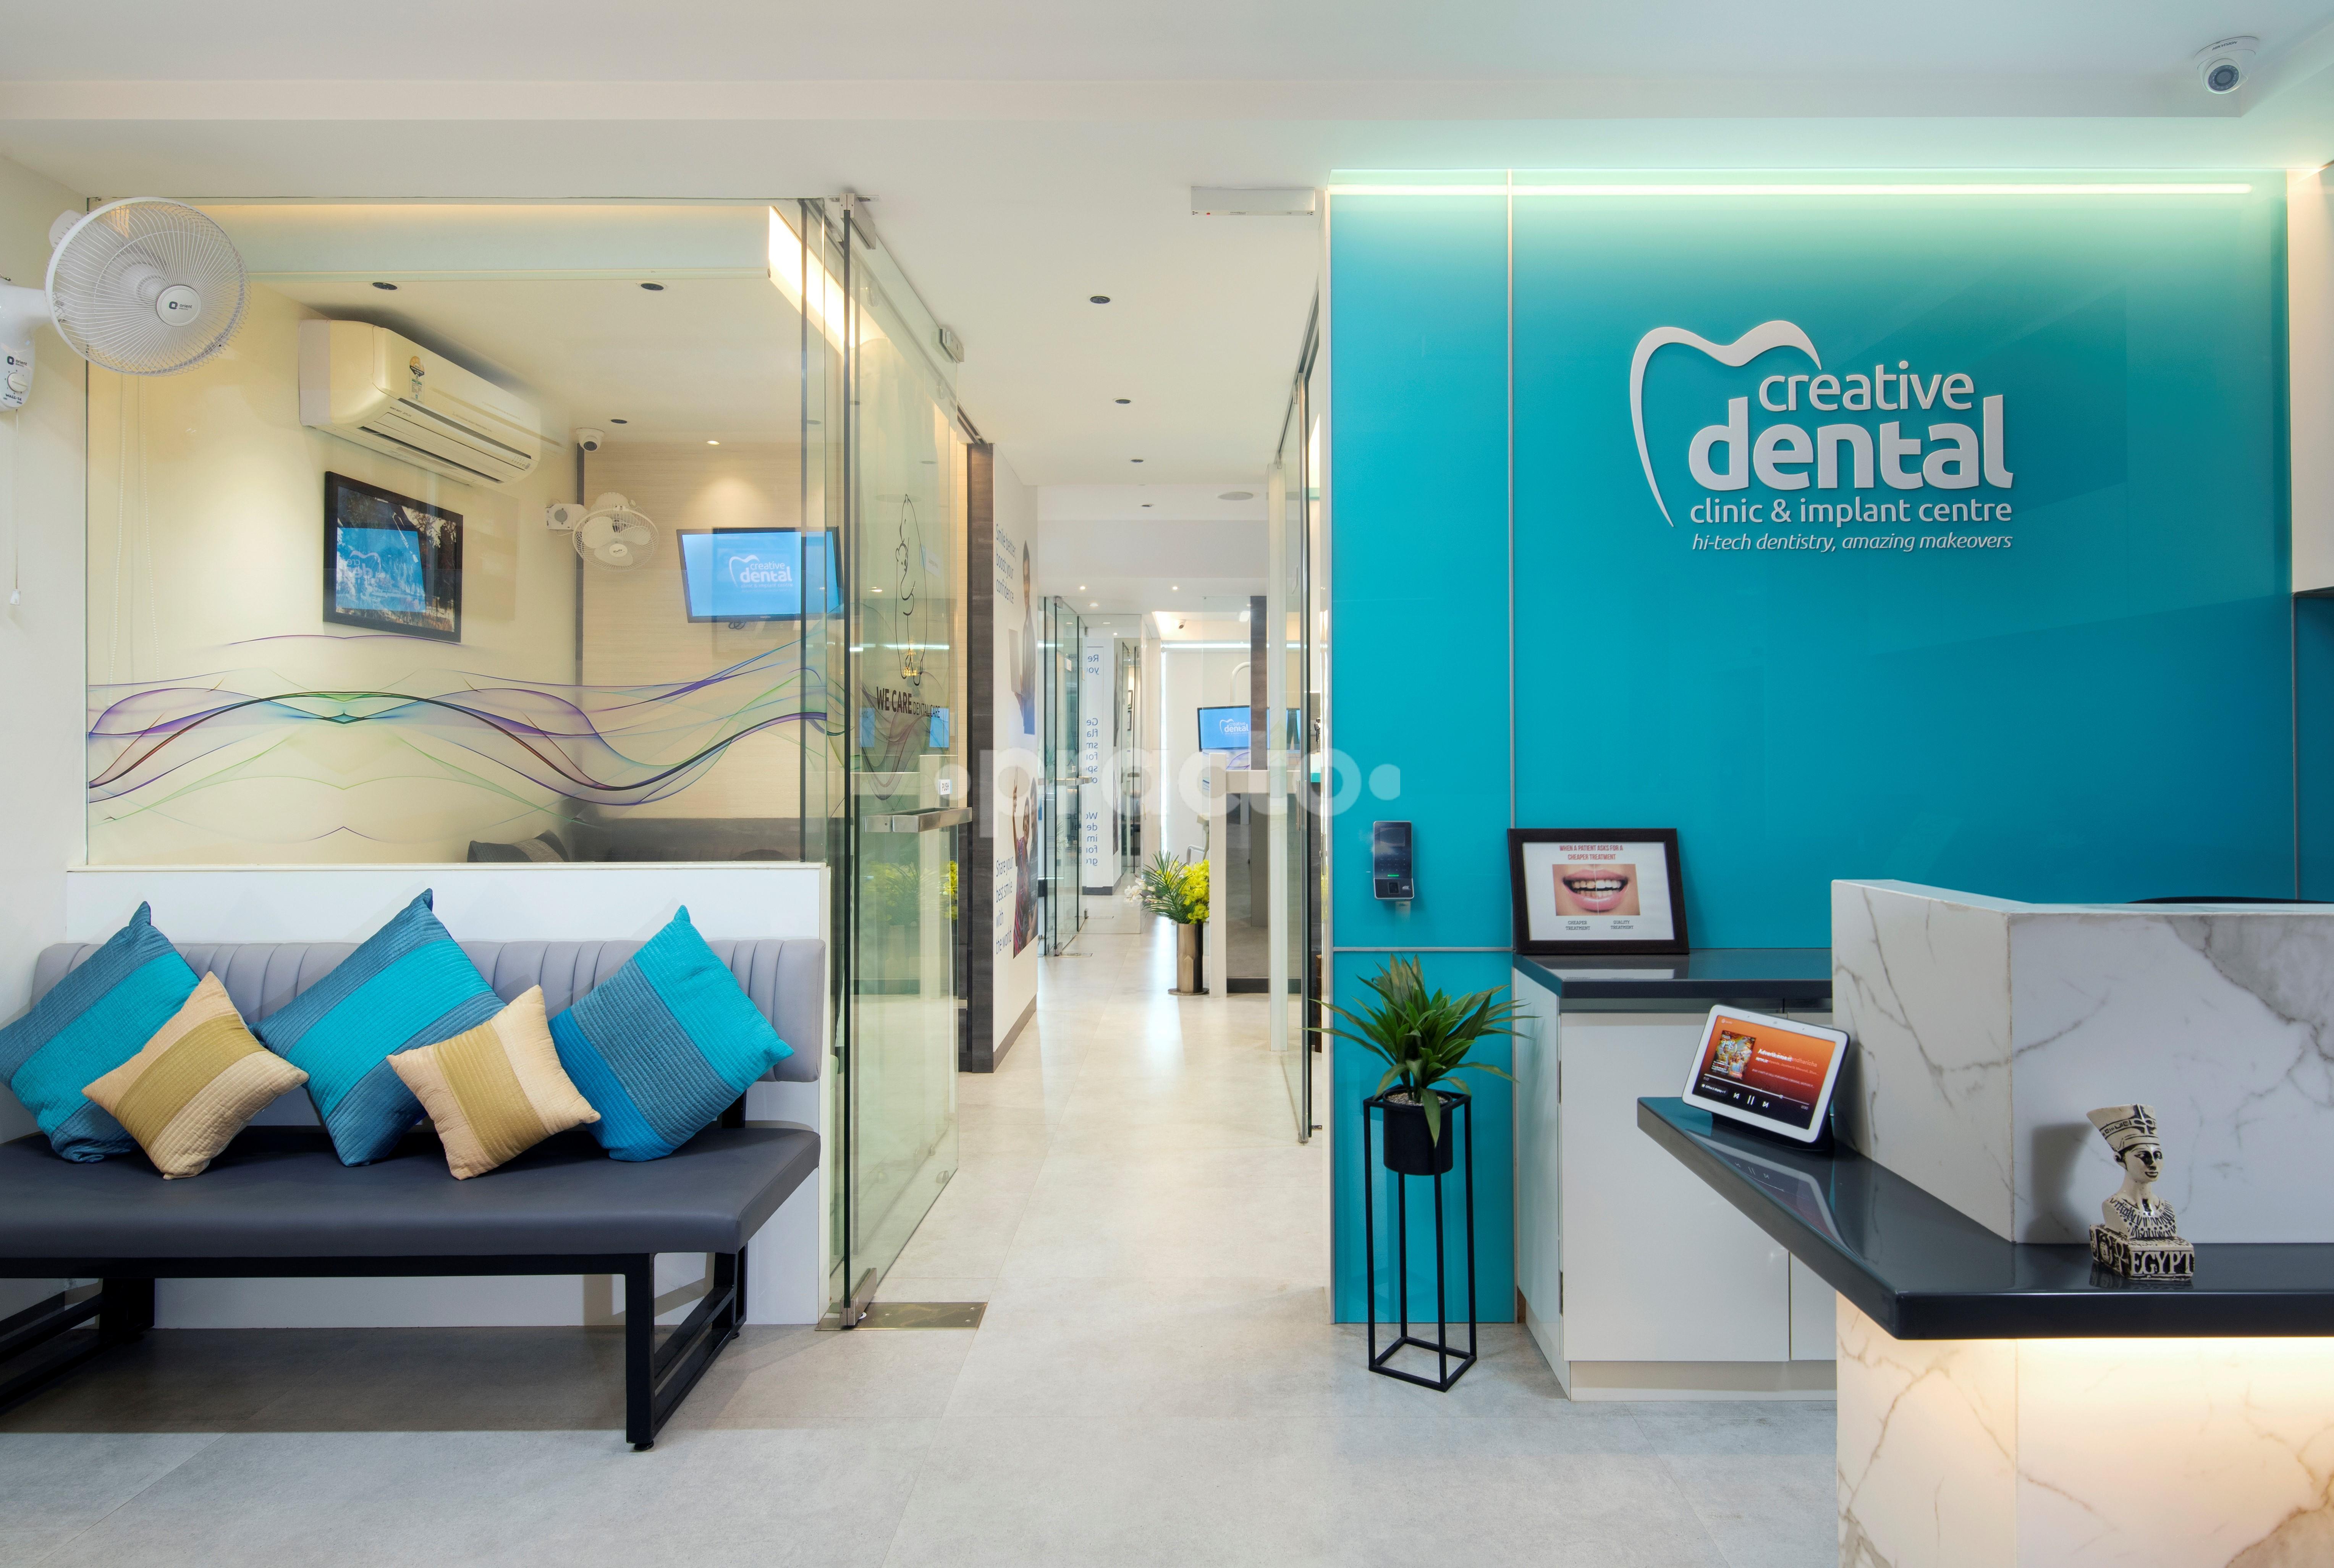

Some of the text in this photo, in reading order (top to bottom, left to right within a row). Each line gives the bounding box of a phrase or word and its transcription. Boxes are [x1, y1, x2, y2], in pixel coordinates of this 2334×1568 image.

[2212, 40, 2237, 51] HIKVISION
[1758, 360, 1974, 412] creative
[1688, 394, 2013, 491] dental
[1690, 496, 2012, 528] clinic & implant centre
[996, 523, 1005, 548] Smile
[1692, 532, 2013, 553] hi-tech dentistry, amazing makeovers
[751, 561, 785, 569] creative
[996, 547, 1006, 574] boost
[740, 566, 792, 582] dental
[996, 579, 1014, 604] confidence
[876, 686, 890, 711] WE
[892, 690, 912, 714] CARE
[913, 702, 930, 716] DENTAL
[930, 705, 940, 718] CARE
[1224, 724, 1249, 732] dental
[996, 858, 1006, 877] Share
[1004, 877, 1012, 897] smile
[1002, 925, 1012, 948] world
[2130, 1252, 2194, 1274] EGYPT
